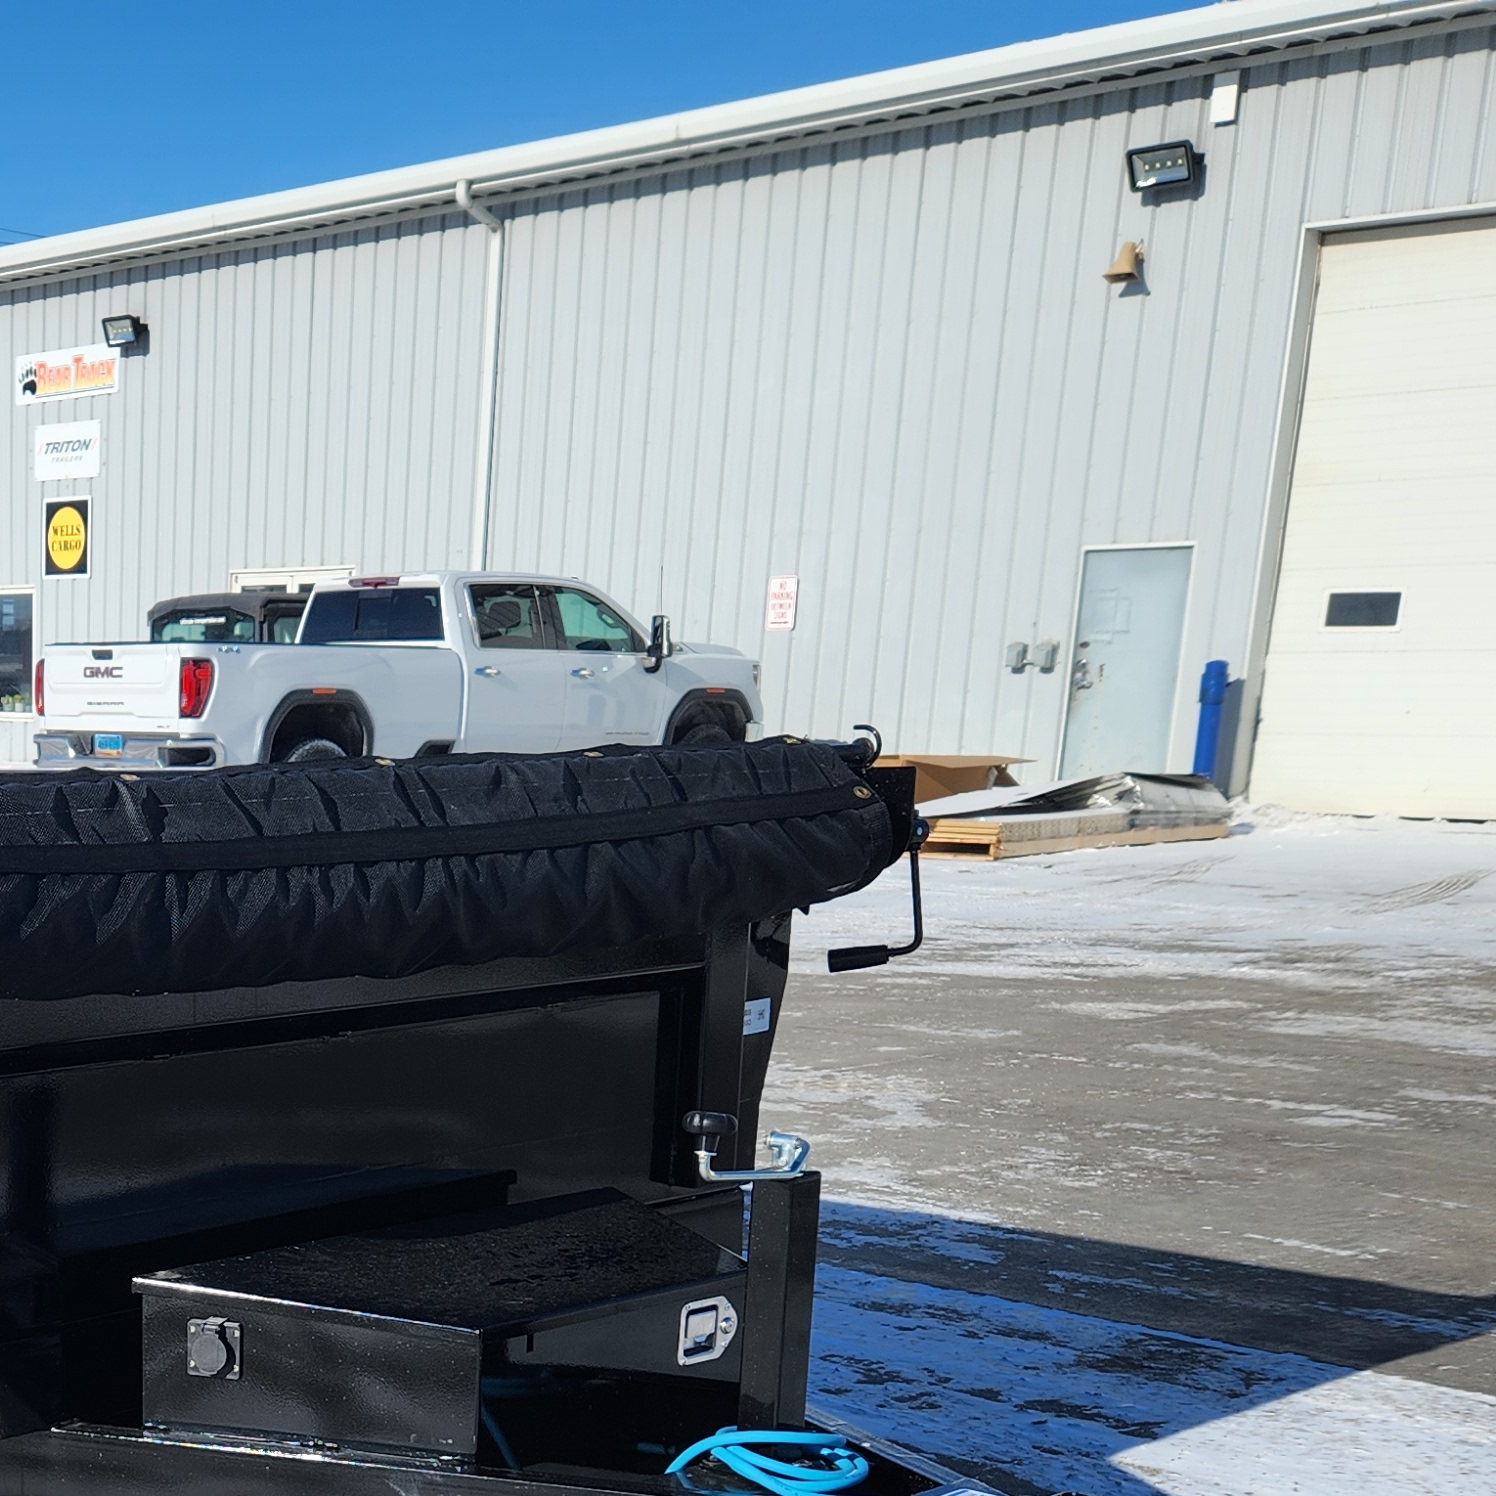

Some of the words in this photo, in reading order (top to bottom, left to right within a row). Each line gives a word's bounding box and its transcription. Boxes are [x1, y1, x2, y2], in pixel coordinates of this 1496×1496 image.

[44, 439, 92, 455] TRITON
[52, 524, 81, 537] WELLS
[51, 540, 81, 552] CARGO
[83, 667, 123, 678] GMC
